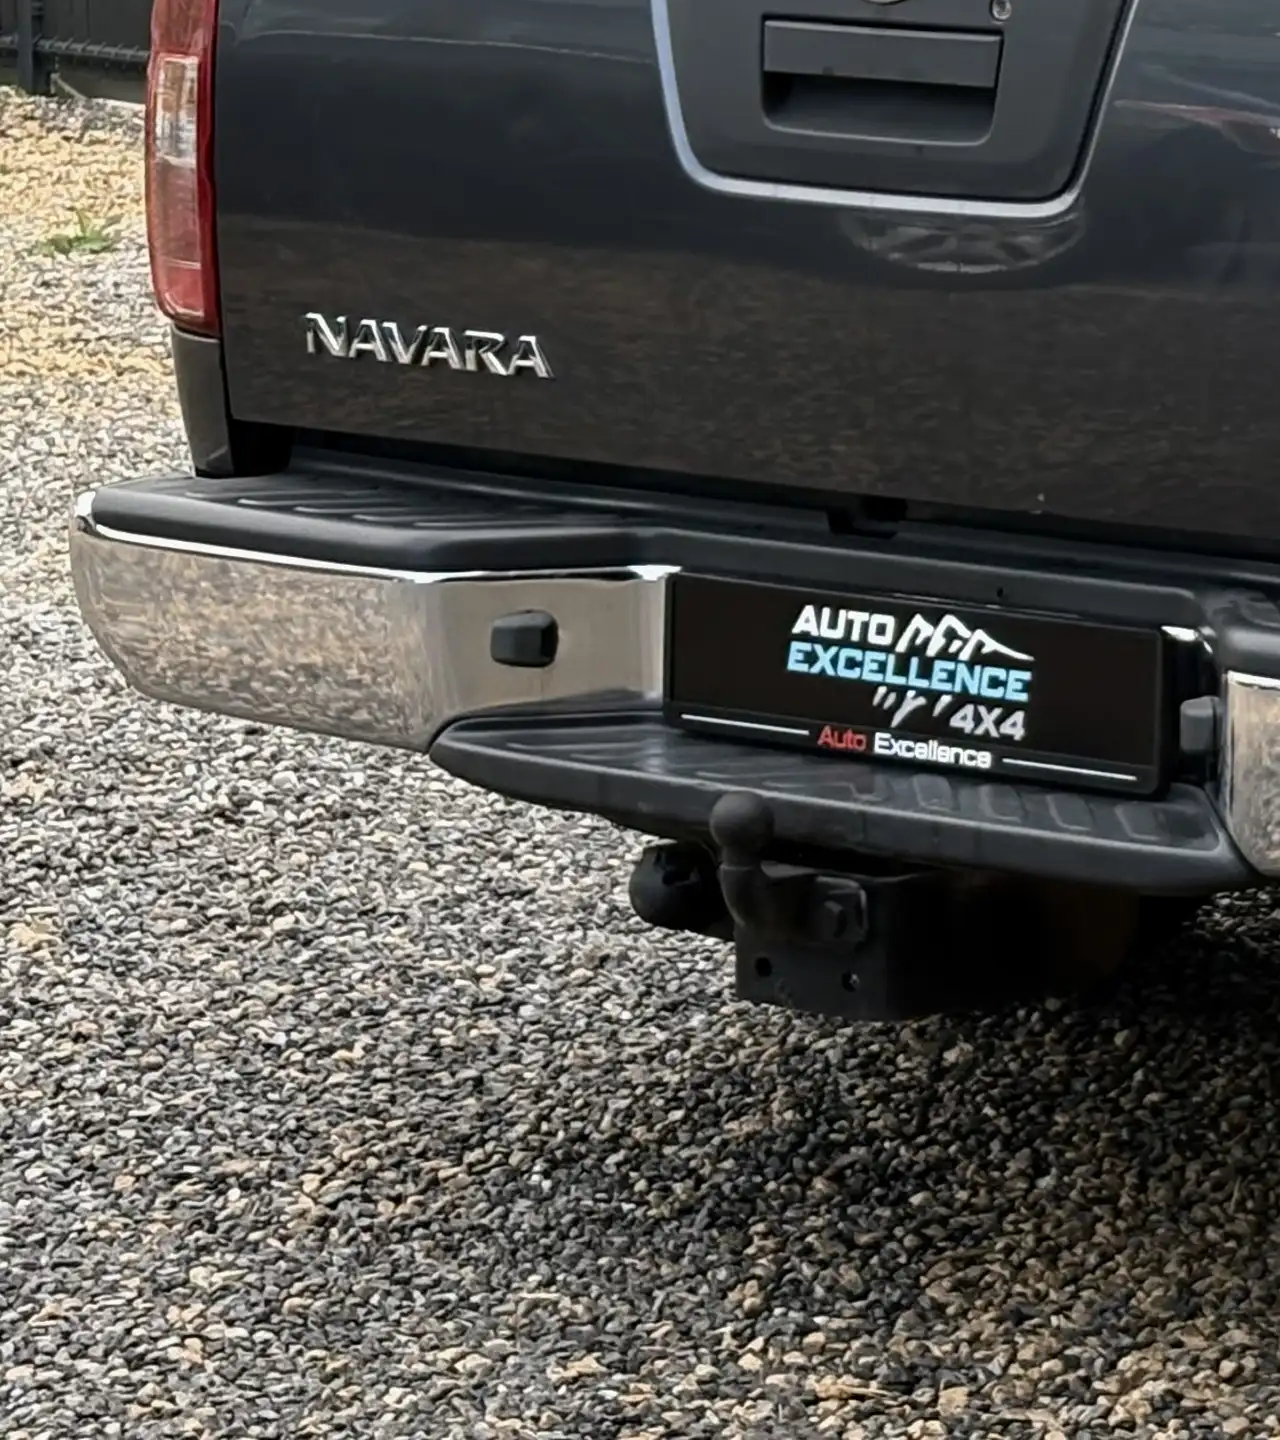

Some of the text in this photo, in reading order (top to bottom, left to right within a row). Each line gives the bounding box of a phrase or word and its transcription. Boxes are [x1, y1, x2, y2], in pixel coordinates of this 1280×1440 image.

[305, 311, 555, 379] NAVARA
[791, 604, 896, 646] AUTO
[786, 641, 1032, 702] EXCELLENCE
[949, 702, 1027, 741] 4X4
[816, 725, 992, 768] Auto Excellence
